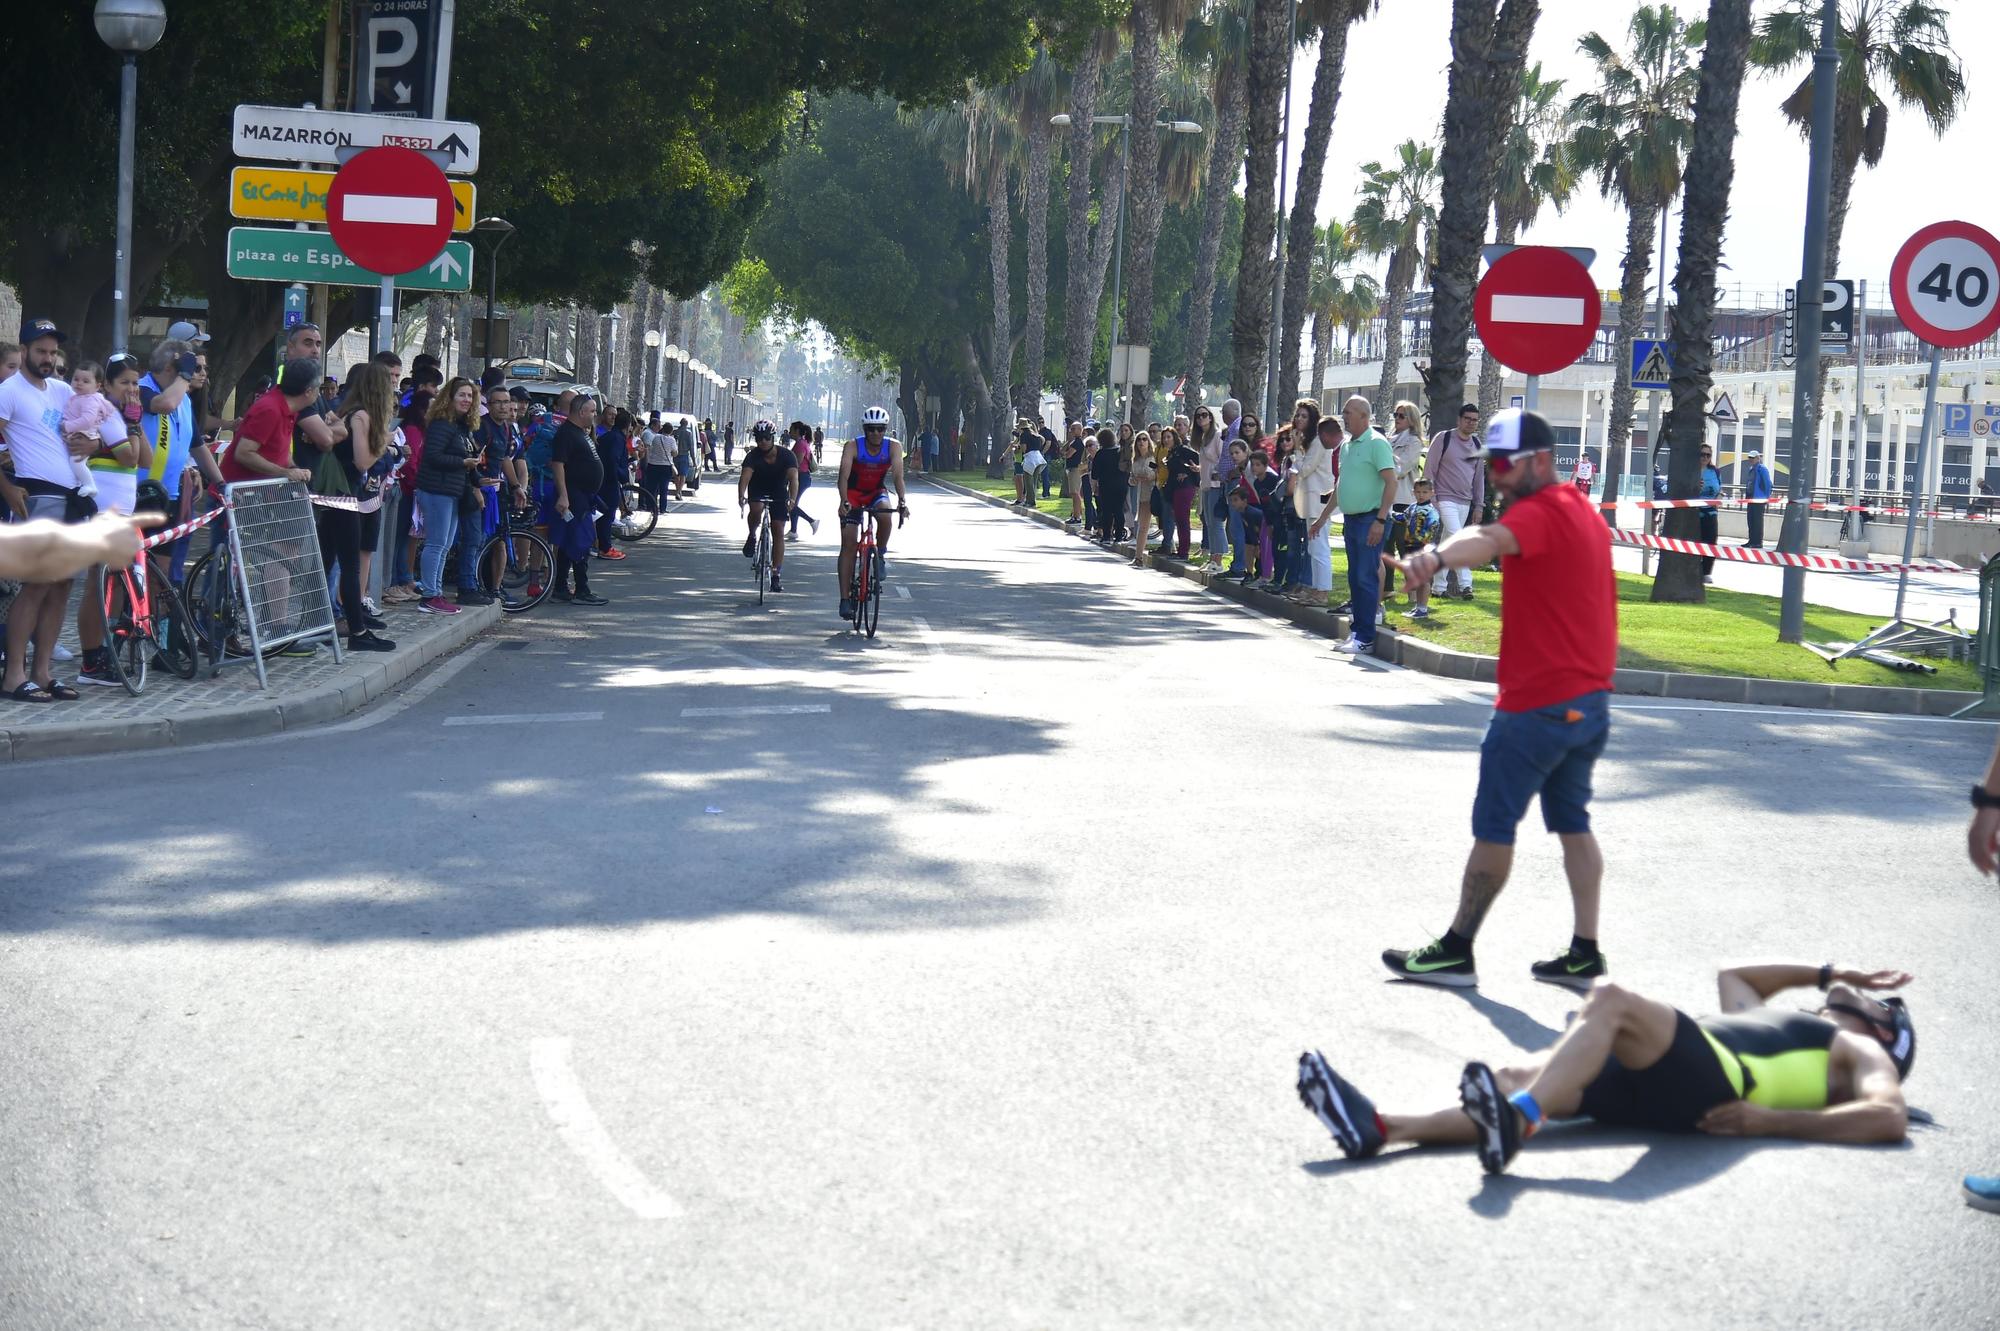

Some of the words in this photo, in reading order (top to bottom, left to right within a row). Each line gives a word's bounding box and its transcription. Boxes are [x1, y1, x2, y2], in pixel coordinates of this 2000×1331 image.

[384, 1, 395, 11] 24
[397, 0, 428, 11] HORAS
[368, 16, 418, 104] P
[243, 123, 352, 147] MAZARRÓN
[384, 135, 431, 149] N-332
[241, 181, 258, 200] El
[300, 180, 327, 210] Ing
[236, 249, 275, 262] plaza
[282, 252, 299, 263] de
[306, 249, 356, 269] Espa
[1918, 262, 1989, 308] 40
[738, 378, 749, 391] P
[1951, 407, 1966, 428] P
